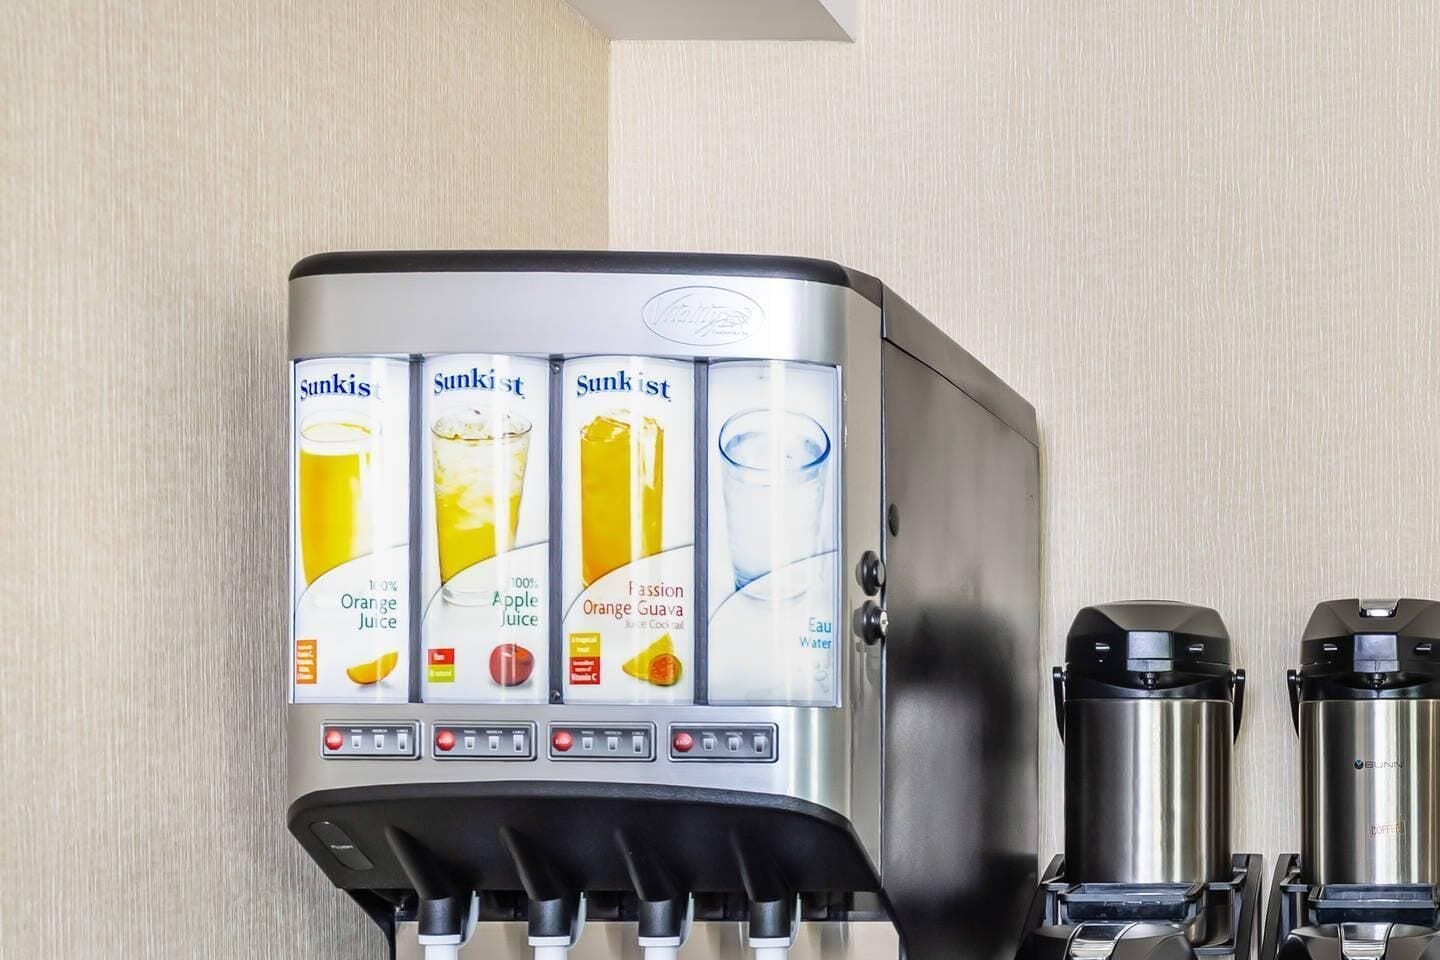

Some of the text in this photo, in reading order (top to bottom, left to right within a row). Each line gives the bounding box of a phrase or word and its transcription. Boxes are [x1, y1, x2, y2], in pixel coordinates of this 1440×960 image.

[433, 367, 524, 398] Sunkist
[577, 370, 670, 400] Sunkist
[341, 593, 397, 614] Orange
[492, 590, 538, 611] Apple
[583, 599, 684, 619] Orange Guava
[358, 612, 397, 630] Juice
[500, 610, 538, 628] Juice
[808, 617, 832, 632] Eau
[800, 636, 832, 648] Water
